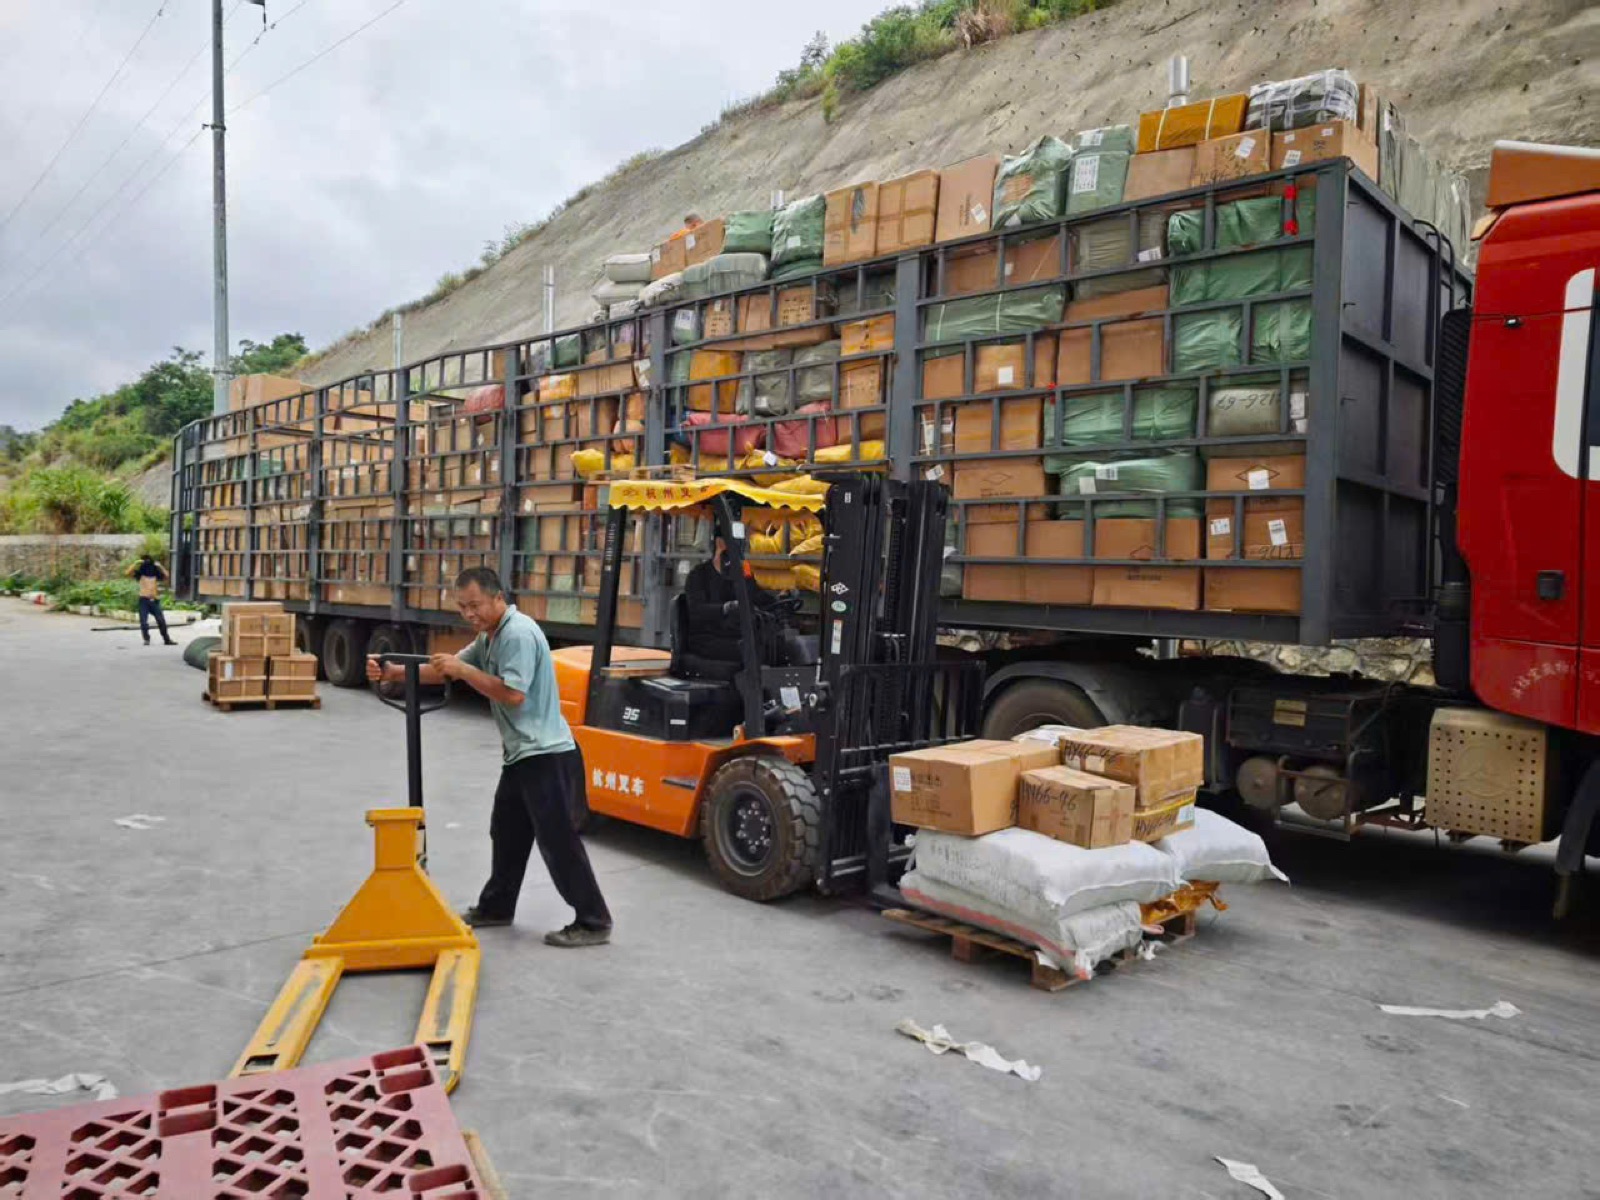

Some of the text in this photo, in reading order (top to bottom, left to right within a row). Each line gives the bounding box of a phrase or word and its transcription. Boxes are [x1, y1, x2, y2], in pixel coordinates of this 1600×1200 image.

[622, 706, 640, 721] 35
[593, 768, 644, 796] 杭州叉车
